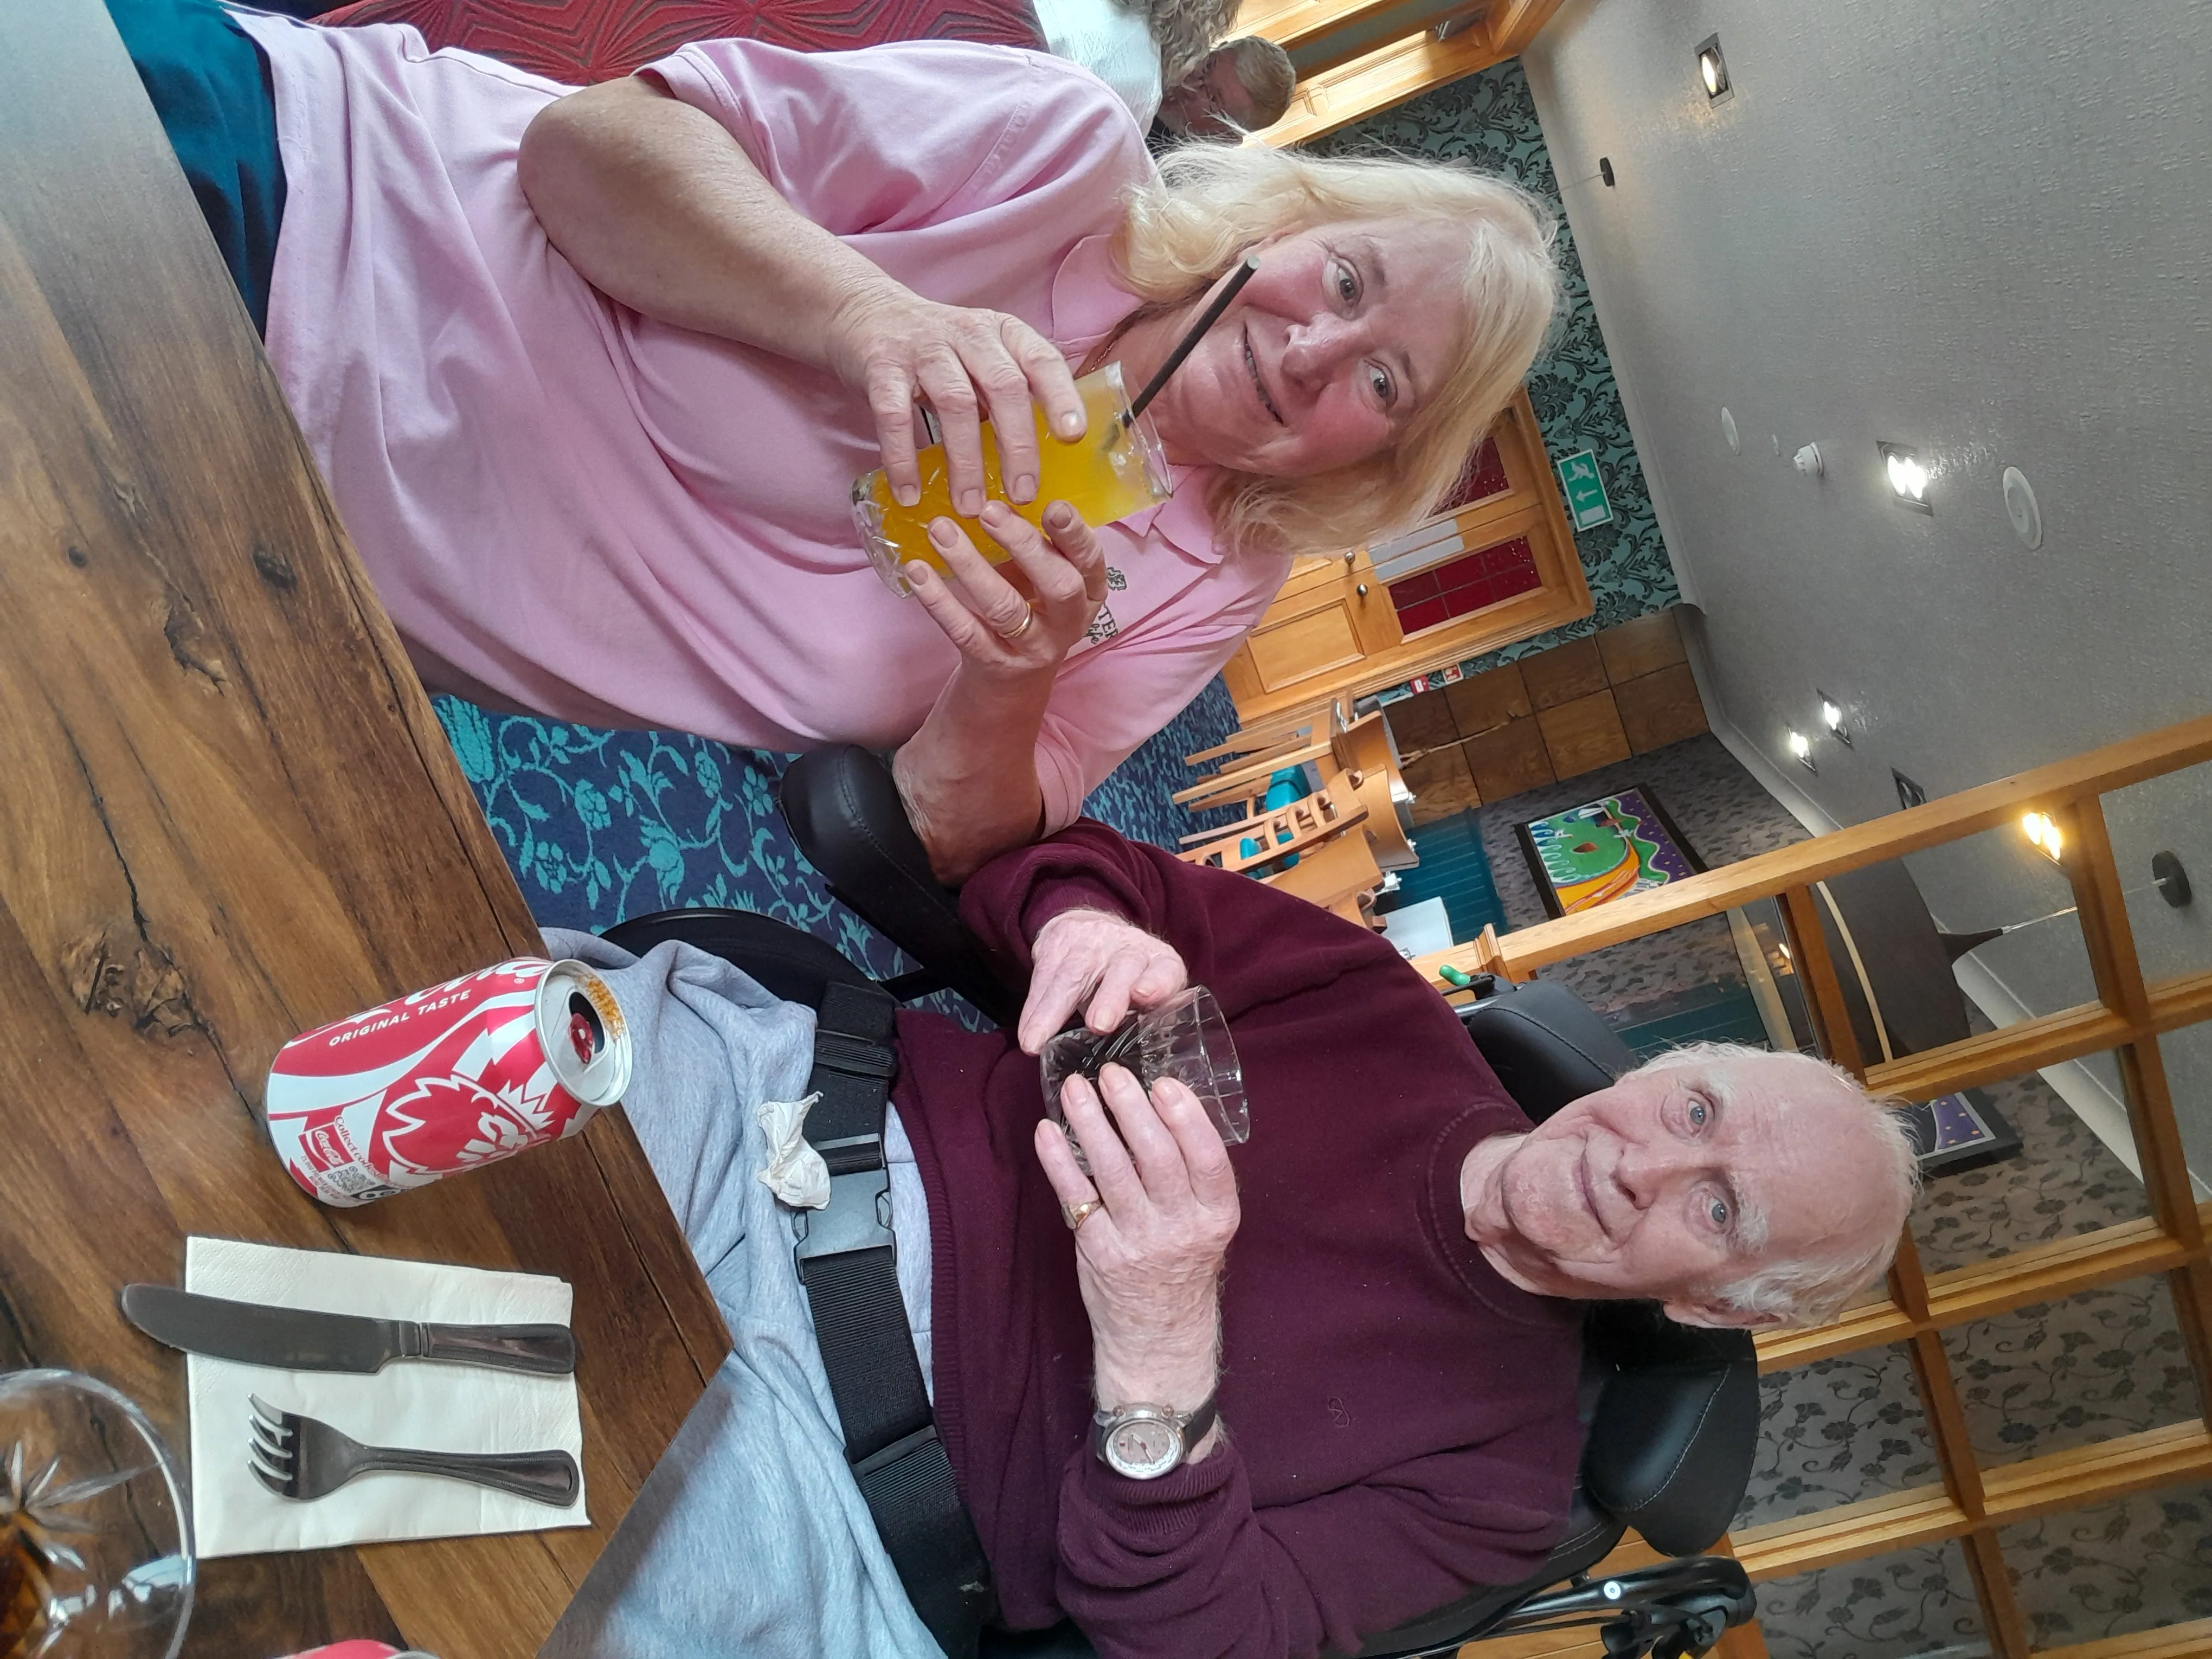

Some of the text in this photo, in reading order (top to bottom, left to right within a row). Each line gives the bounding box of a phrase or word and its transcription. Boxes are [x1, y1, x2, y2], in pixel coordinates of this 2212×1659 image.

[329, 989, 471, 1046] ORIGINAL TASTE
[335, 1116, 358, 1153] Collect
